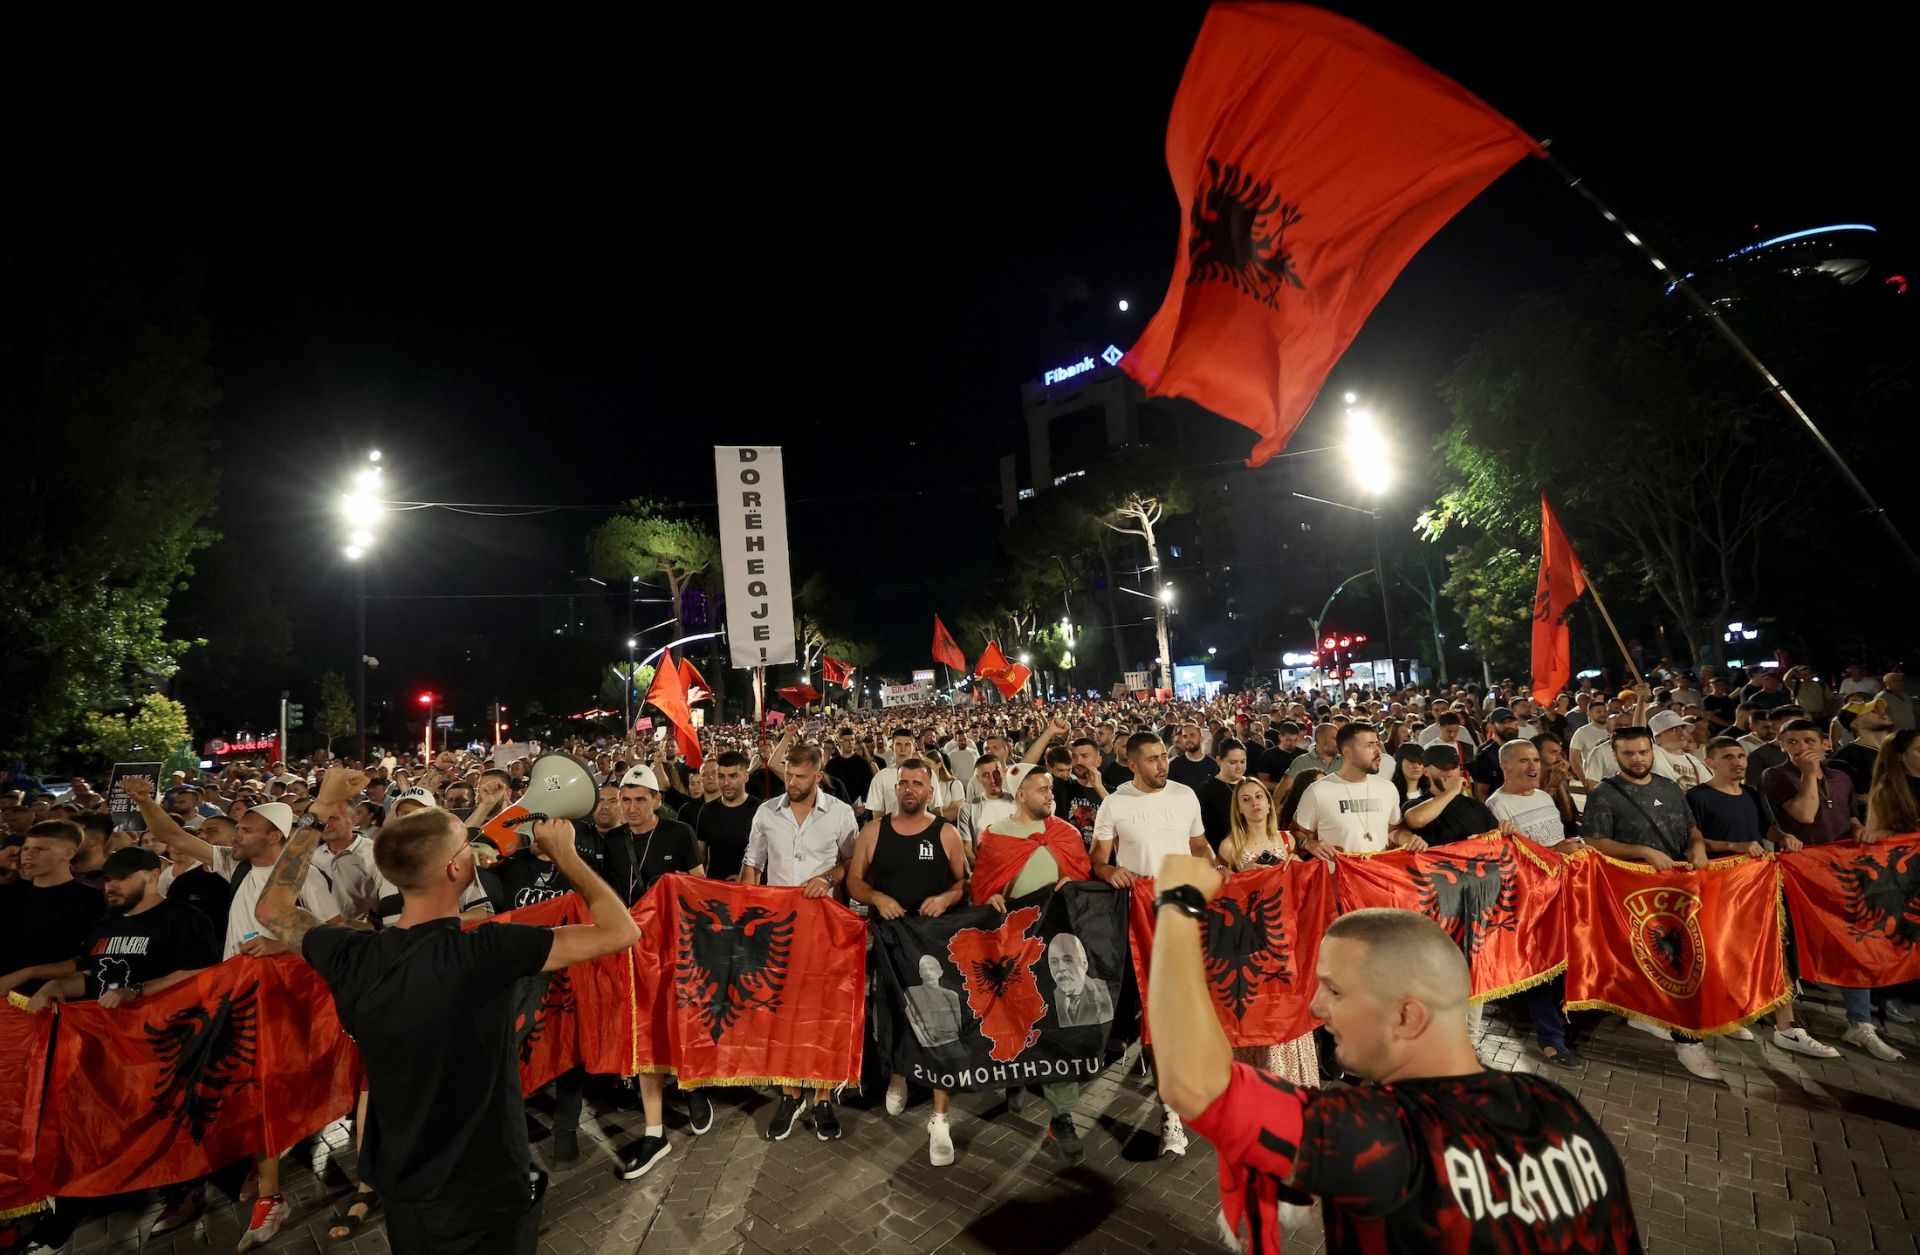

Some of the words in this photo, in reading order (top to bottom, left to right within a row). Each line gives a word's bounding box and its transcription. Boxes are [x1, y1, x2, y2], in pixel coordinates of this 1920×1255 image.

[1045, 356, 1095, 386] Fibank
[739, 448, 770, 662] DORËHEQJE!
[231, 741, 274, 751] vodafon
[1339, 799, 1383, 813] PUMA
[1630, 891, 1694, 918] UÇK
